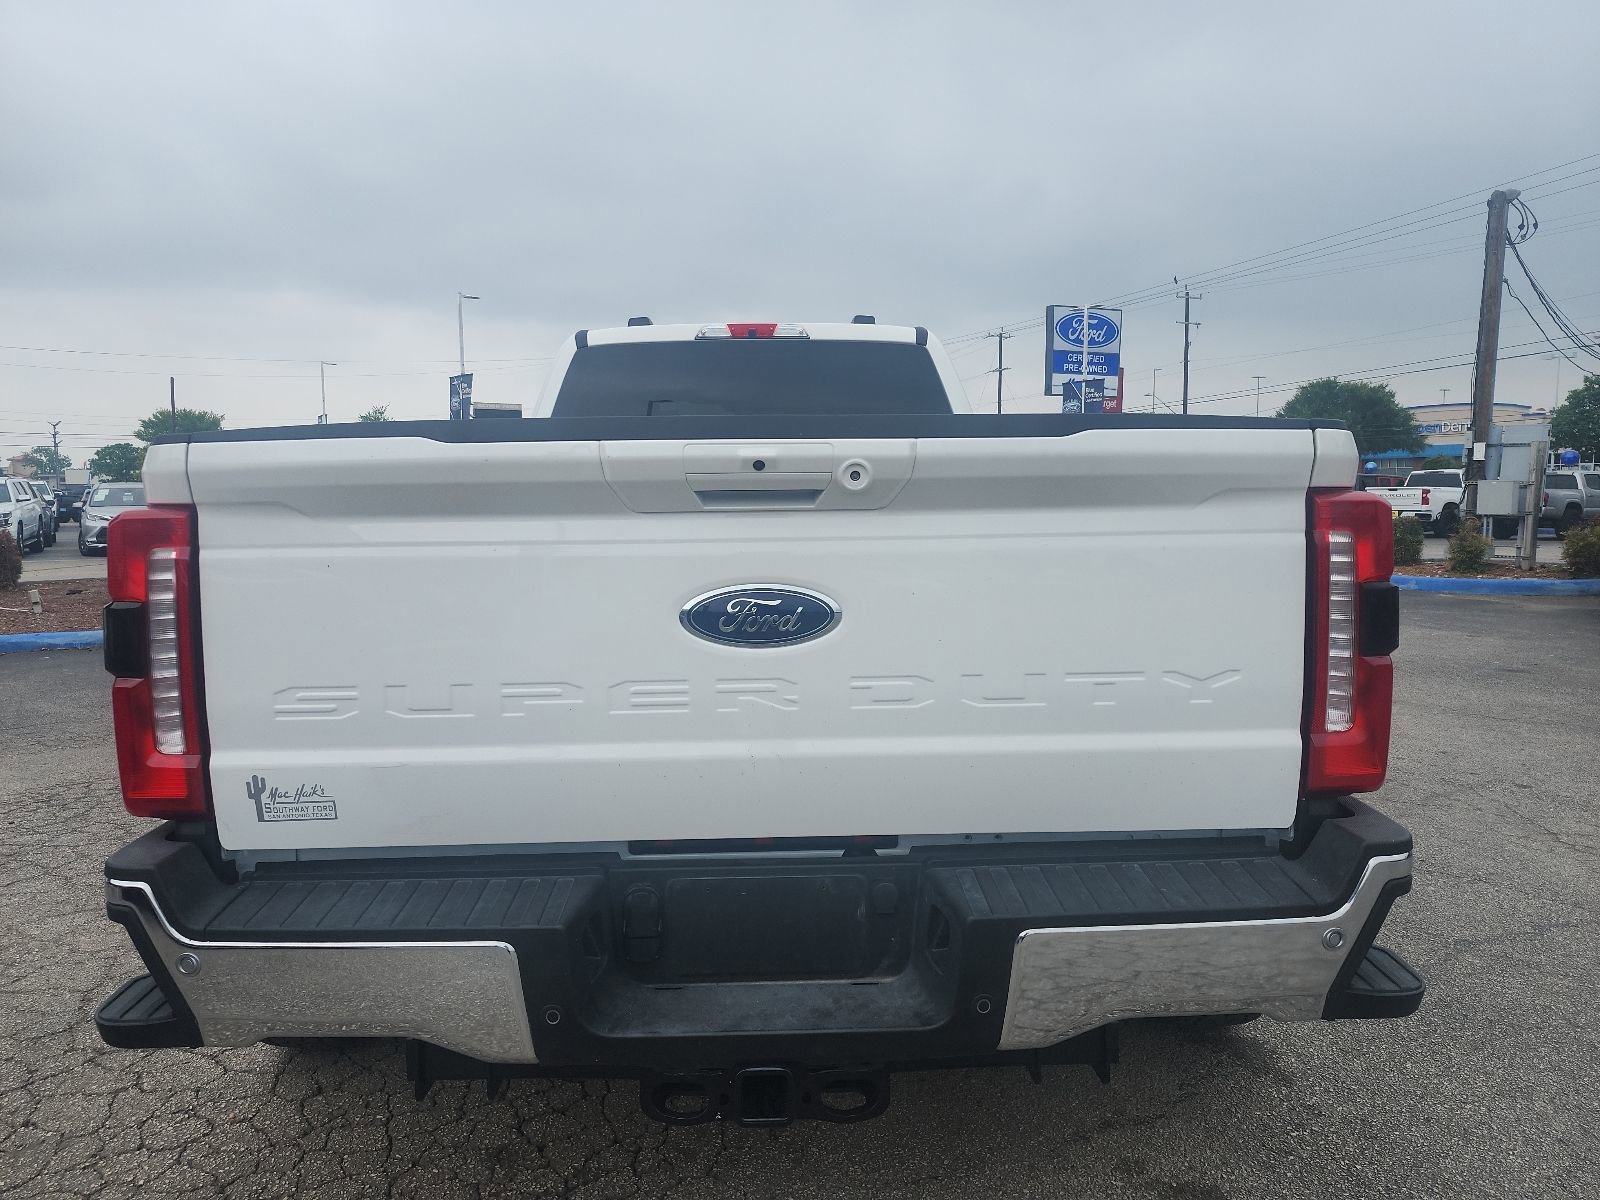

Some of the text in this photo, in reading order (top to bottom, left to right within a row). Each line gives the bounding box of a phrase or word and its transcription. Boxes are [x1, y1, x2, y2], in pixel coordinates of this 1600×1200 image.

[1068, 317, 1108, 342] Ford
[1067, 353, 1105, 363] CERIFIED
[718, 598, 803, 632] Ford
[273, 669, 1241, 721] SUPER DUTY
[266, 783, 333, 805] Mac Haik's
[264, 802, 310, 813] SOUTHWAY
